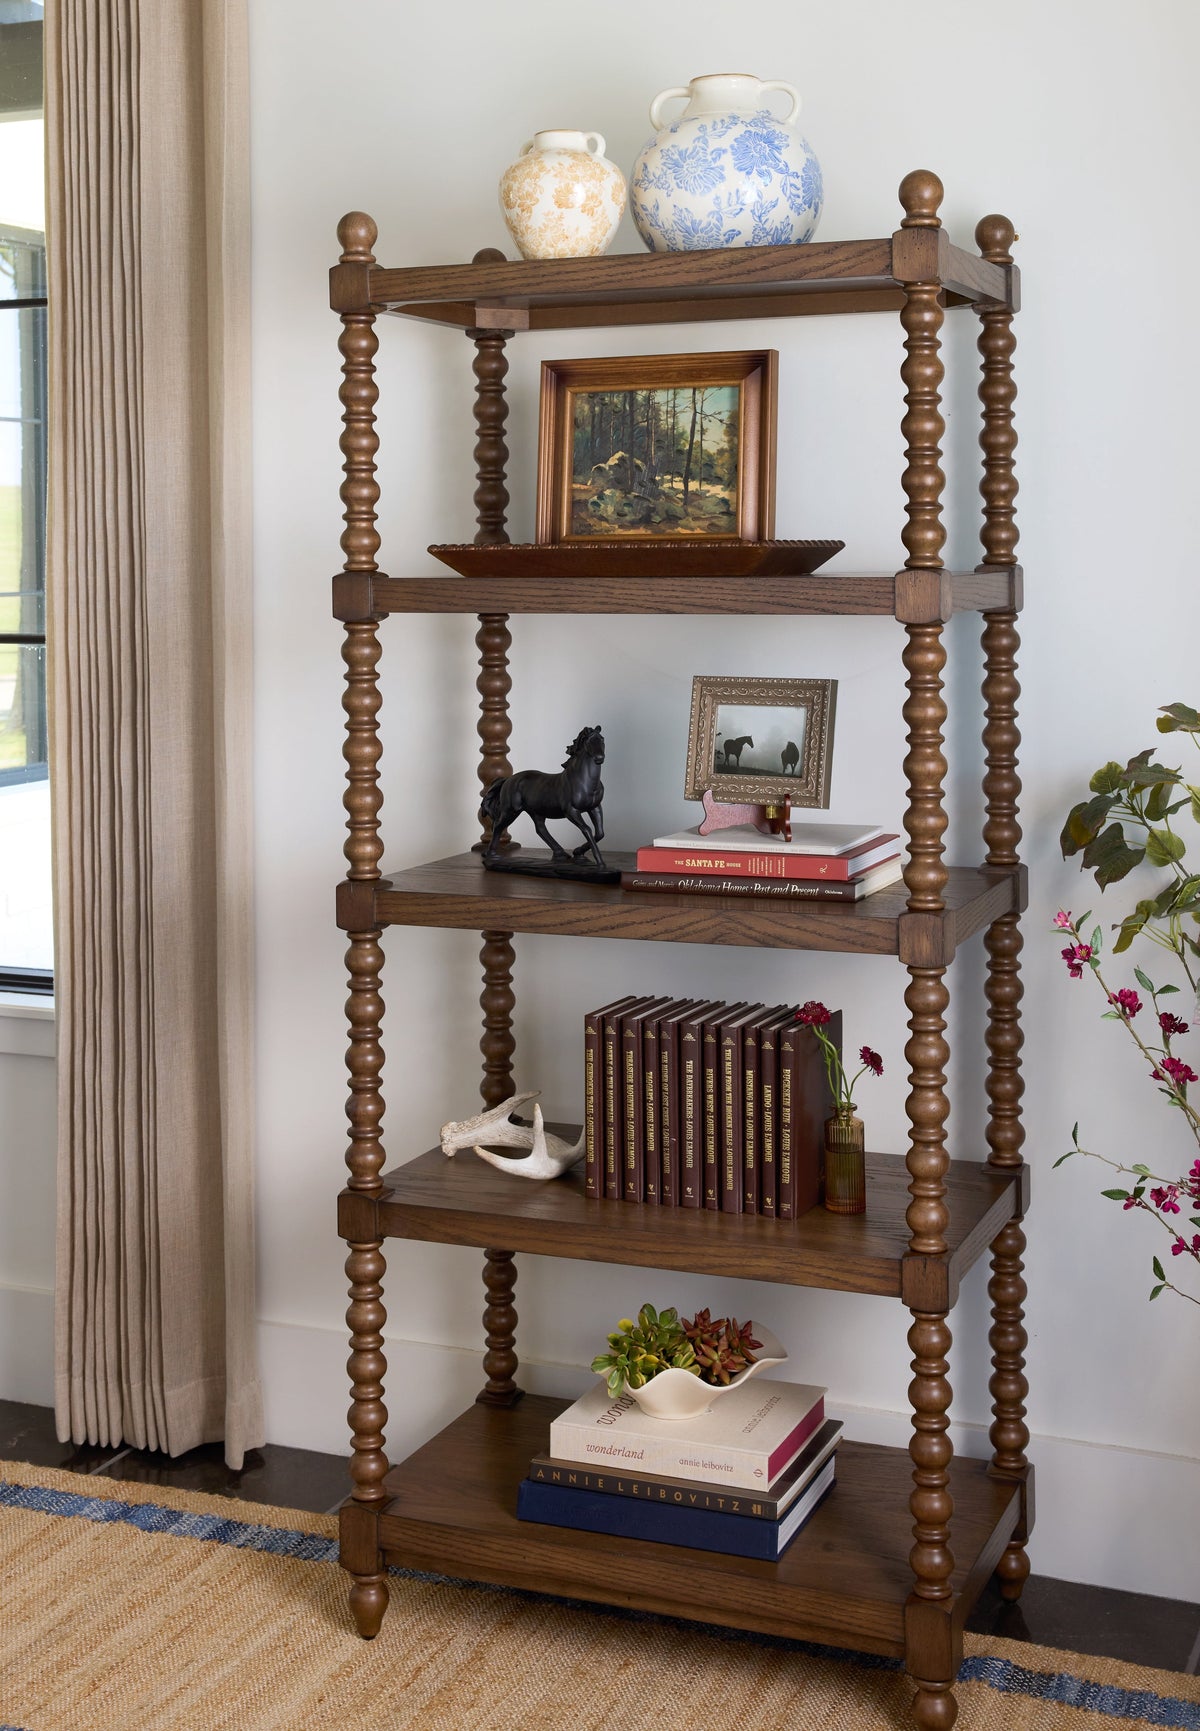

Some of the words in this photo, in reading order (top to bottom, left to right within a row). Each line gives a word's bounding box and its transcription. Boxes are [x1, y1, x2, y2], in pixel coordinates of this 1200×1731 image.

[685, 859, 713, 868] SANTA
[715, 860, 726, 868] FE
[678, 879, 721, 892] Oklahoma
[754, 883, 771, 894] Past
[771, 883, 790, 894] and
[791, 884, 819, 896] Present
[626, 1051, 634, 1084] TREASURE
[646, 1072, 654, 1101] TAGGART
[662, 1083, 669, 1092] OF
[706, 1069, 714, 1092] RIVERS
[782, 1069, 790, 1107] BUCKSKIN
[586, 1096, 594, 1114] TRAIL
[626, 1084, 634, 1118] MOUNTAIN
[706, 1094, 714, 1112] WEST
[764, 1085, 772, 1107] LANDO
[646, 1103, 654, 1123] LOUIS
[764, 1111, 772, 1132] LOUIS
[782, 1107, 790, 1123] RUN
[586, 1116, 594, 1135] LOUIS
[706, 1115, 714, 1135] LOUIS
[746, 1120, 754, 1140] LOUIS
[586, 1136, 594, 1163] L'AMOUR
[764, 1132, 772, 1162] L'AMOUR
[782, 1129, 790, 1151] LOUIS
[627, 1141, 635, 1169] L'AMOUR
[686, 1141, 694, 1168] L'AMOUR
[746, 1141, 754, 1168] L'AMOUR
[782, 1152, 790, 1184] L'AMOUR
[586, 1443, 645, 1460] wonderland
[679, 1458, 700, 1468] annie
[702, 1460, 734, 1473] leibovitz
[536, 1469, 604, 1488] ANNIE
[618, 1482, 739, 1511] LEIBOVITZ
